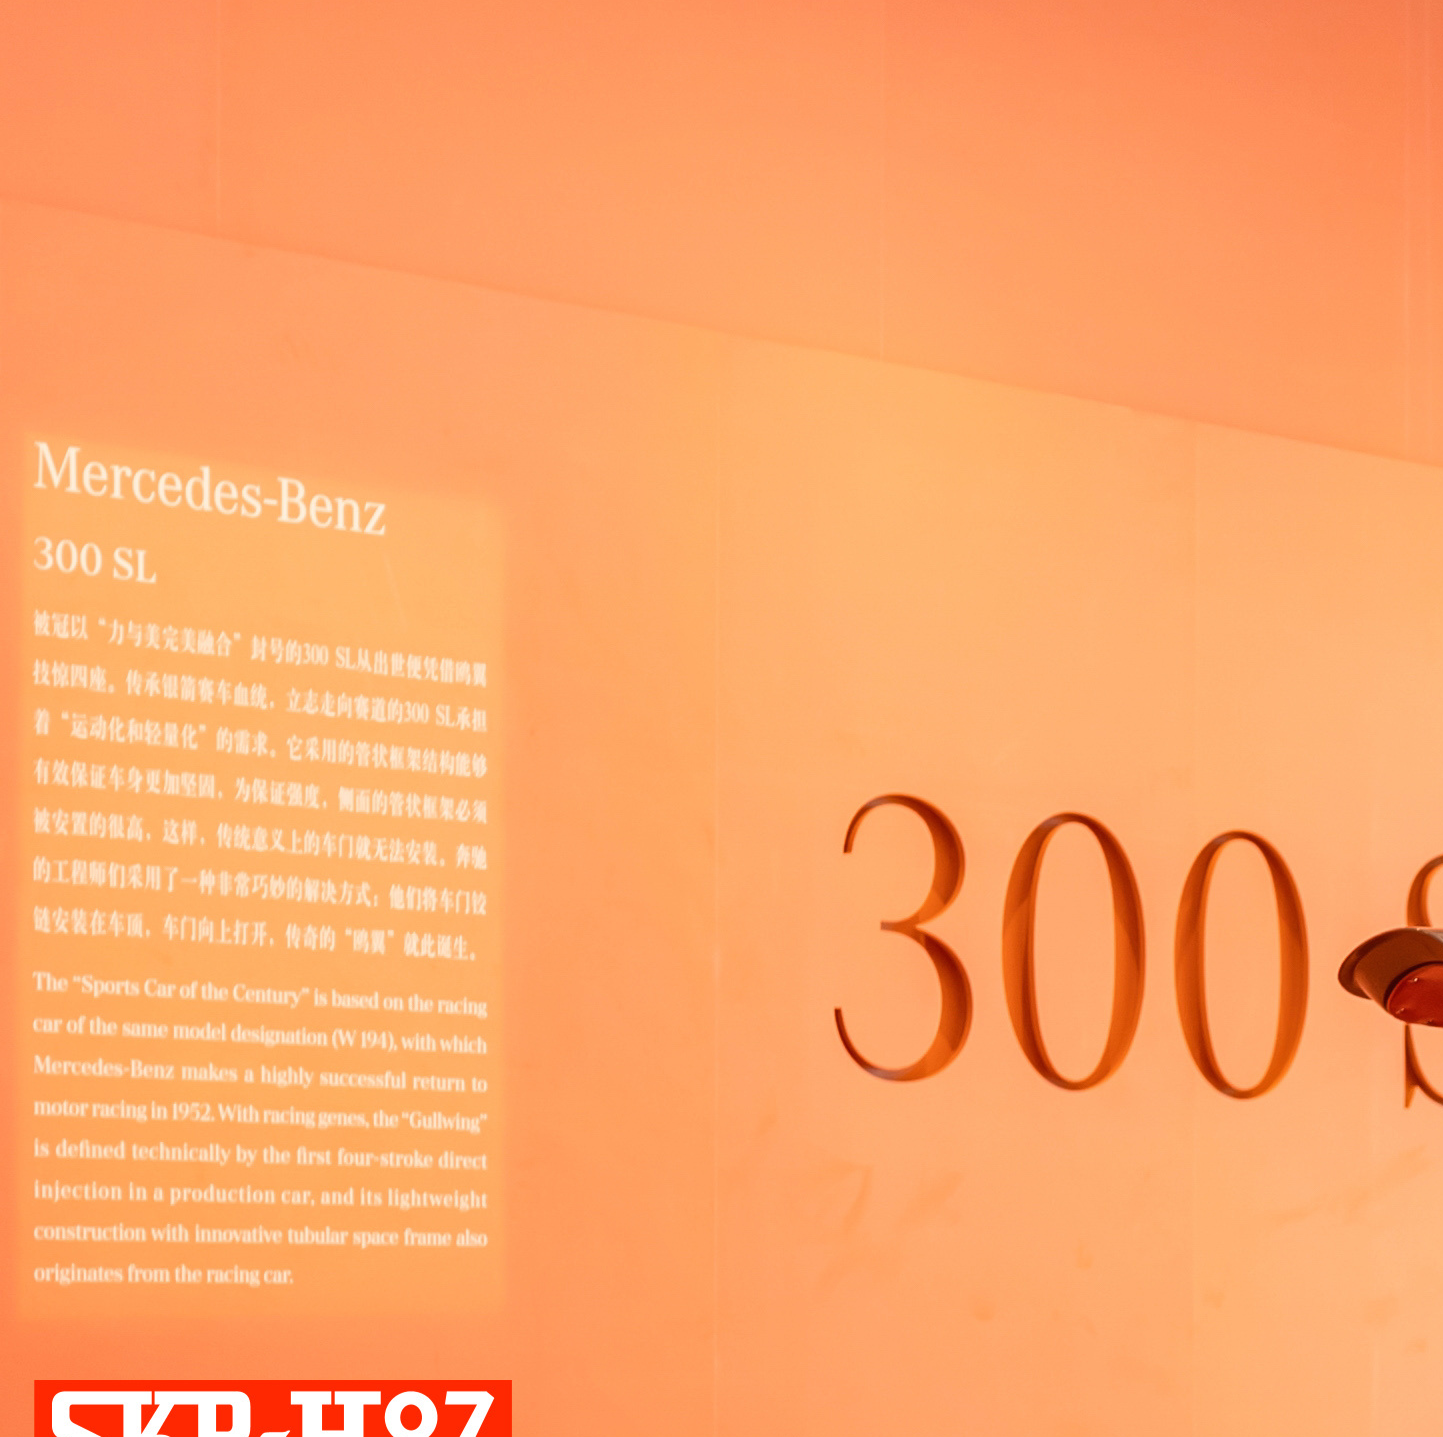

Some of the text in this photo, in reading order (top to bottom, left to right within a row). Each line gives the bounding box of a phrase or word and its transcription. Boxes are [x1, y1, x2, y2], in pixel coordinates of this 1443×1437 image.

[34, 441, 387, 536] Mercedes-Benz
[34, 536, 158, 584] 300 SL
[834, 793, 1310, 1099] 300
[32, 971, 68, 992] The
[144, 978, 176, 998] Car
[179, 980, 198, 1000] of
[201, 982, 228, 1002] the
[314, 988, 328, 1006] is
[332, 988, 380, 1010] based
[382, 996, 404, 1011] on
[408, 994, 434, 1012] the
[438, 996, 488, 1019] racing
[32, 1015, 488, 1054] car of the same model designation (W 194), with which
[34, 1054, 488, 1093] Mercedes-Benz makes a highly successful return to
[34, 1100, 89, 1118] motor
[92, 1100, 148, 1122] racing
[151, 1100, 168, 1120] in
[172, 1102, 215, 1122] 1952.
[218, 1103, 260, 1124] With
[263, 1106, 316, 1129] racing
[318, 1112, 370, 1130] genes,
[372, 1109, 400, 1128] the
[34, 1138, 488, 1170] is defined technically by the first four-stroke direct
[34, 1179, 488, 1212] injection in a production car, and its lightweight
[34, 1222, 488, 1250] construction with innovative tubular space frame also
[34, 1262, 294, 1288] originates from the racing car.
